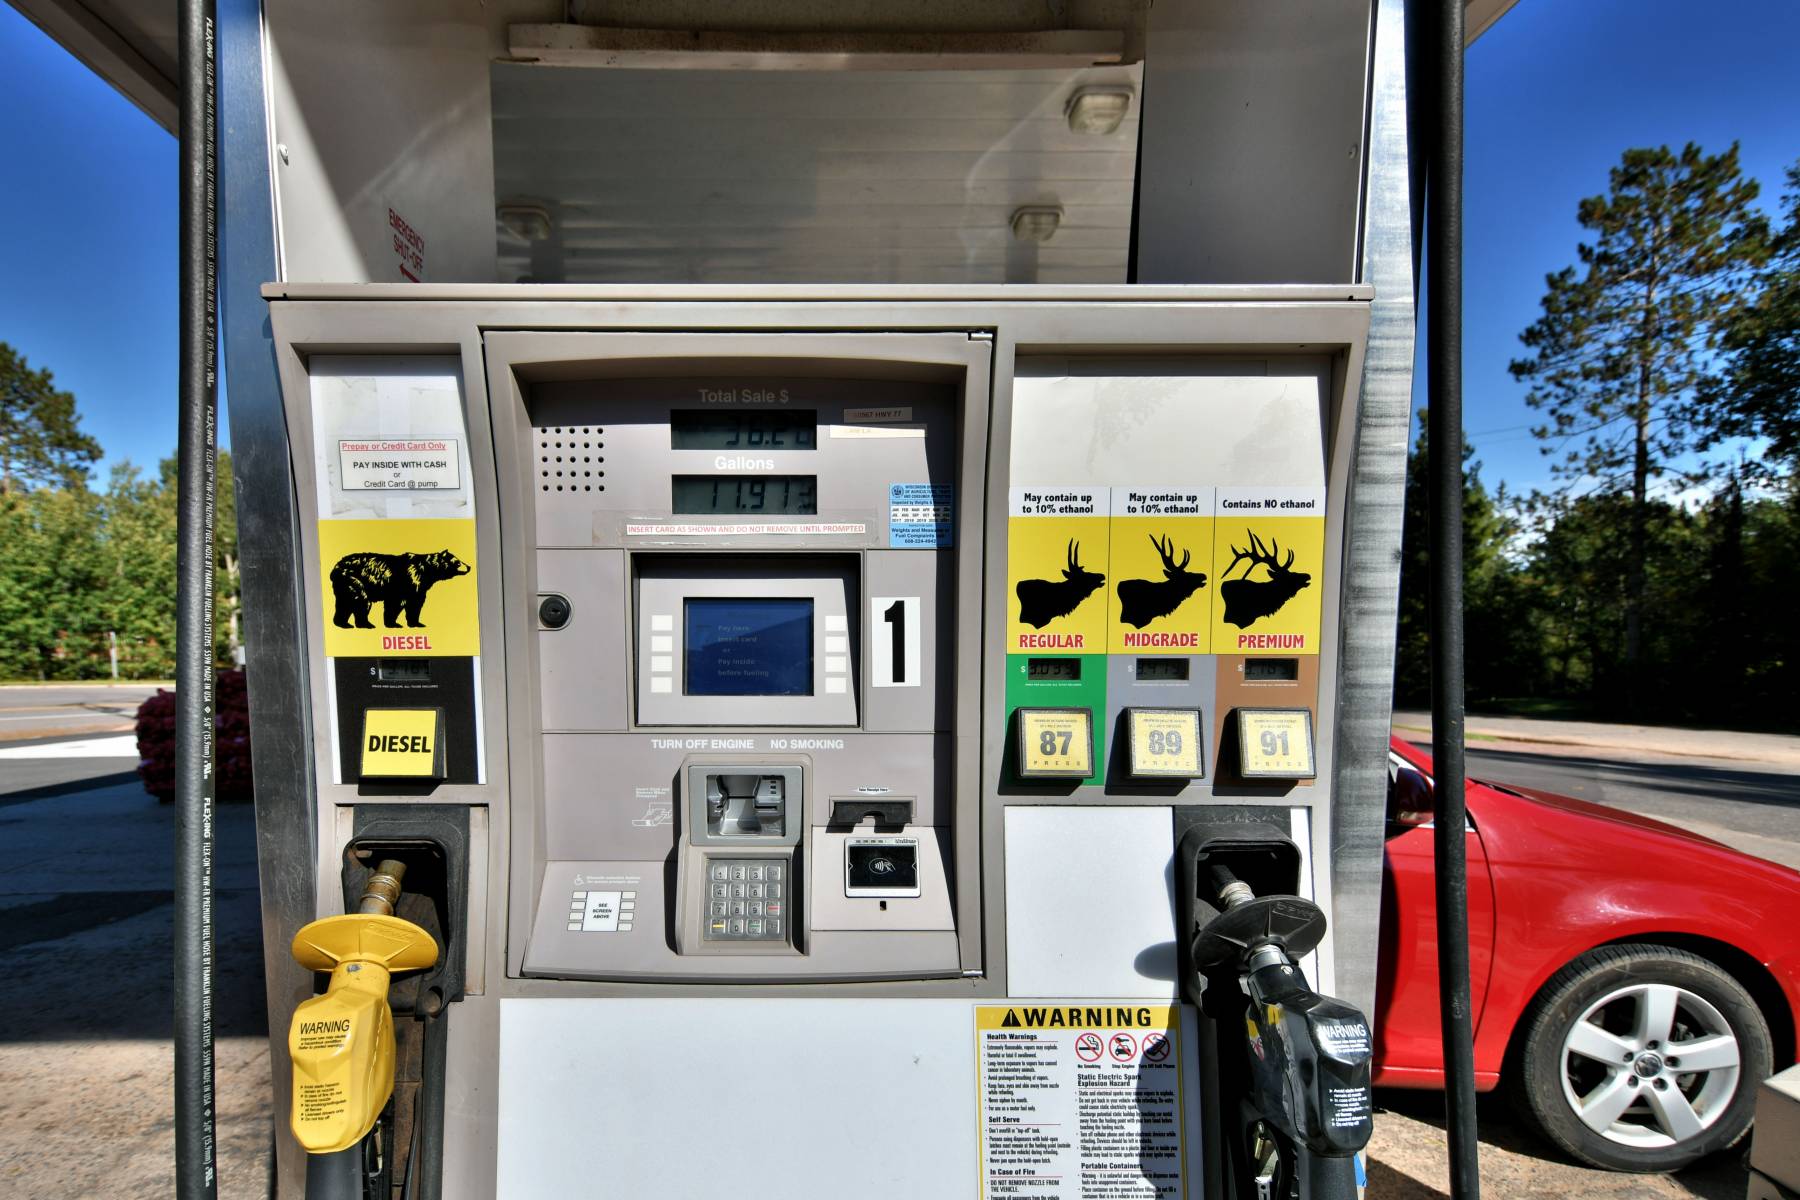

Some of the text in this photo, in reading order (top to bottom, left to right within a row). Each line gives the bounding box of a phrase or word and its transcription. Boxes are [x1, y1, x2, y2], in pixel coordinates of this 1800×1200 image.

[698, 389, 789, 404] Total Sale $
[428, 442, 446, 450] Only
[714, 456, 774, 470] Gallons
[408, 480, 415, 489] @
[1024, 493, 1092, 504] May contain up
[1129, 493, 1197, 504] May contain up
[1223, 500, 1315, 508] Contains NO ethanol
[1022, 504, 1093, 513] to 10% ethanol
[1127, 504, 1198, 513] to 10% ethanol
[383, 636, 432, 650] DIESEL
[884, 600, 905, 682] 1
[1020, 634, 1083, 647] REGULAR
[1124, 634, 1198, 646] MIDGRADE
[1238, 635, 1304, 648] PREMIUM
[368, 735, 431, 753] DIESEL
[650, 740, 754, 749] TURN OFF ENGINE
[770, 739, 844, 749] NO SMOKING
[1040, 731, 1072, 755] 87
[1149, 730, 1182, 755] 89
[1261, 731, 1289, 756] 91
[203, 798, 211, 838] FLEX-ING
[1023, 1008, 1151, 1027] WARNING
[300, 1020, 350, 1034] WARNING
[1320, 1024, 1366, 1038] WARNING
